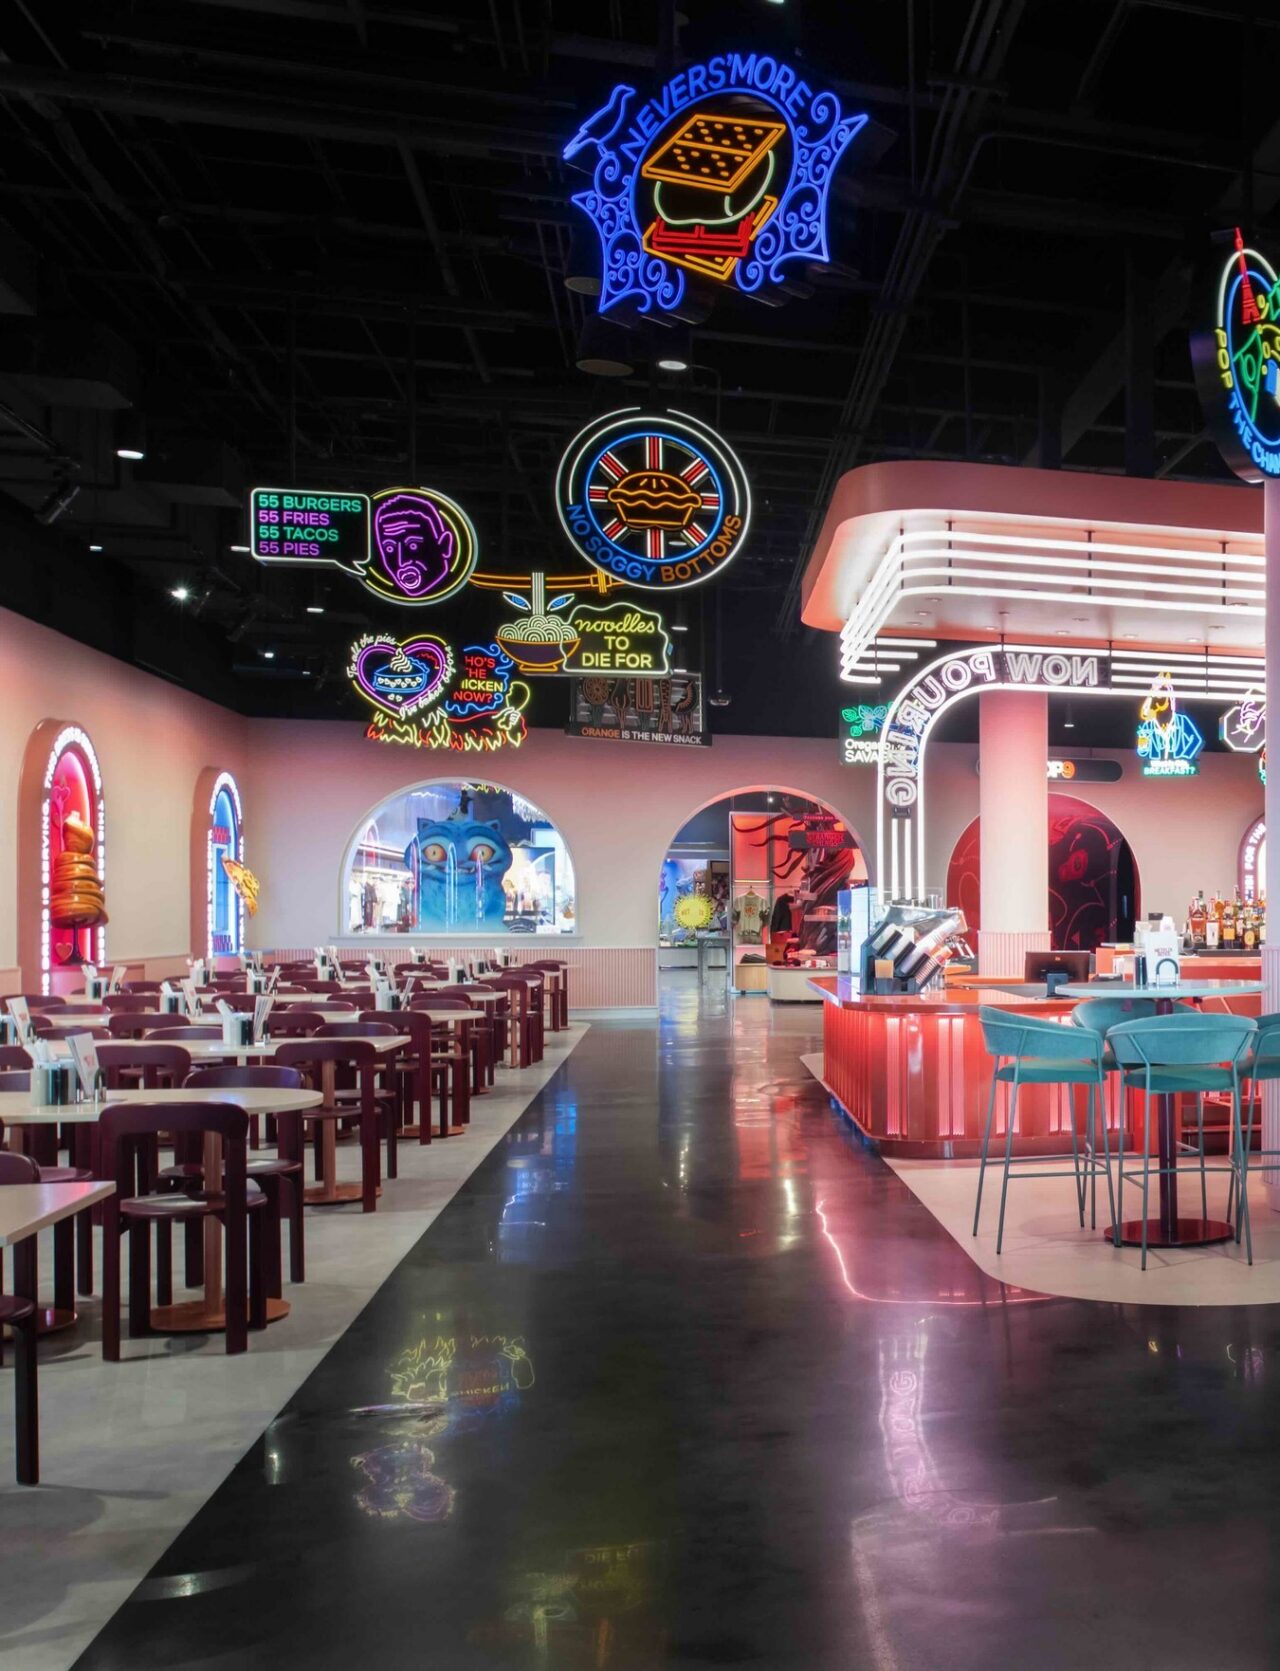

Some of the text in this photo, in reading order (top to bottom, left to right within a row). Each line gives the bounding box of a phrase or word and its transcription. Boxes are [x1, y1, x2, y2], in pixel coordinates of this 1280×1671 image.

[1215, 327, 1234, 388] POP
[1229, 392, 1251, 449] THE
[259, 494, 362, 513] 55 BURGERS
[259, 509, 330, 527] 55 FRIES
[259, 525, 339, 542] 55 TACOS
[259, 540, 321, 556] 55 PIES
[565, 502, 741, 584] NO SOGGY BOTTOMS
[573, 615, 658, 635] noodles
[603, 635, 630, 651] TO
[464, 656, 496, 669] HO'S
[582, 651, 653, 669] DIE FOR
[453, 690, 493, 703] NOW?
[581, 727, 702, 745] ORANGE IS THE NEW SNACK
